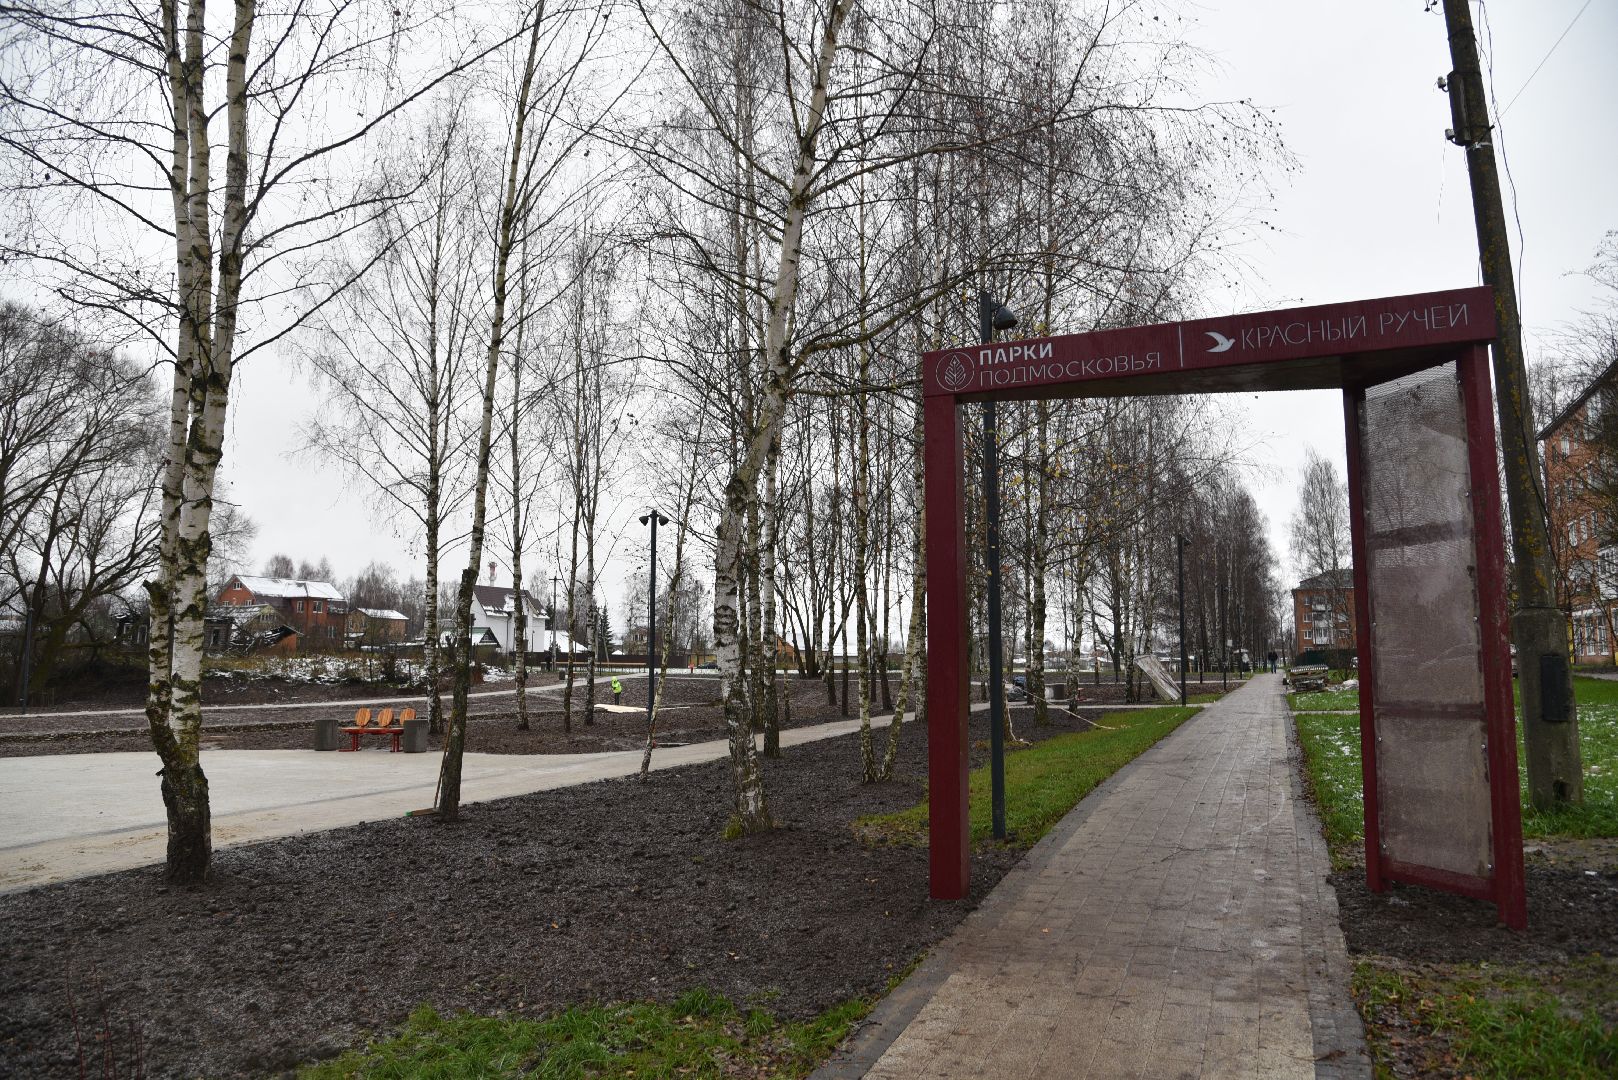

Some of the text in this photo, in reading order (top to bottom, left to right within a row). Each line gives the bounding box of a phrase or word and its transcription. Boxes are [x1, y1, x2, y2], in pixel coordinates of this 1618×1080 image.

[1242, 303, 1469, 350] КРАСНЫЙ РУЧЕЙ
[979, 342, 1053, 366] ПАРКИ
[980, 352, 1161, 387] ПОДМОСКОВЬЯ
